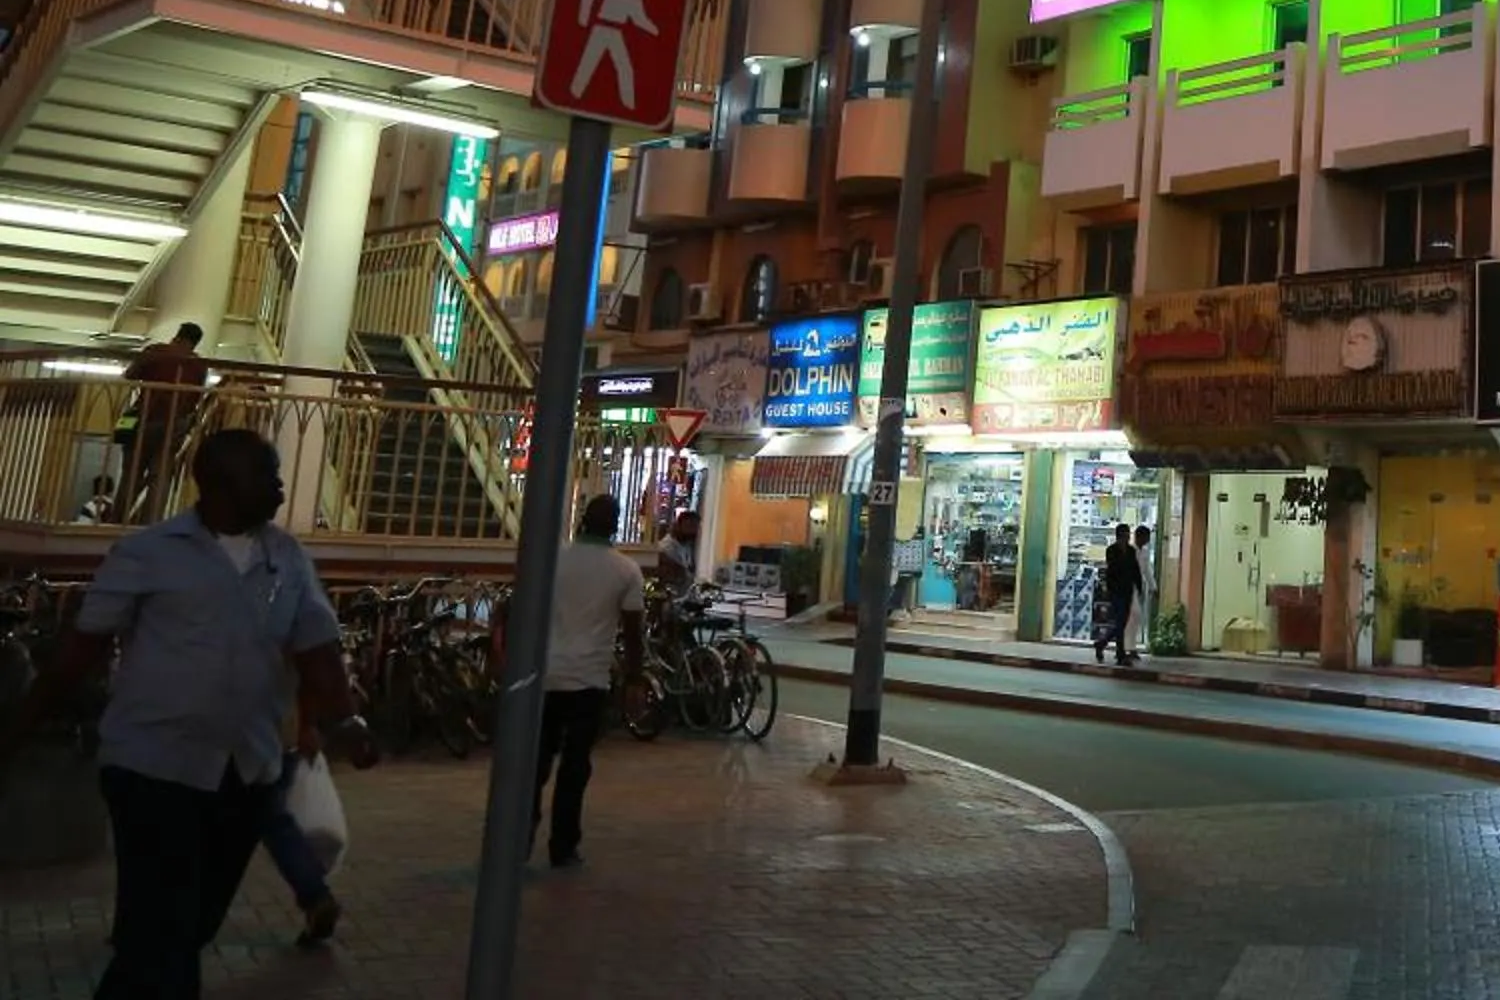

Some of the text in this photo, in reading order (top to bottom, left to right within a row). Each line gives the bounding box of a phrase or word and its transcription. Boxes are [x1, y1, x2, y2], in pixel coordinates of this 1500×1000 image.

[767, 363, 855, 397] DOLPHIN
[765, 400, 849, 418] GUEST HOUSE
[873, 484, 893, 501] 27
